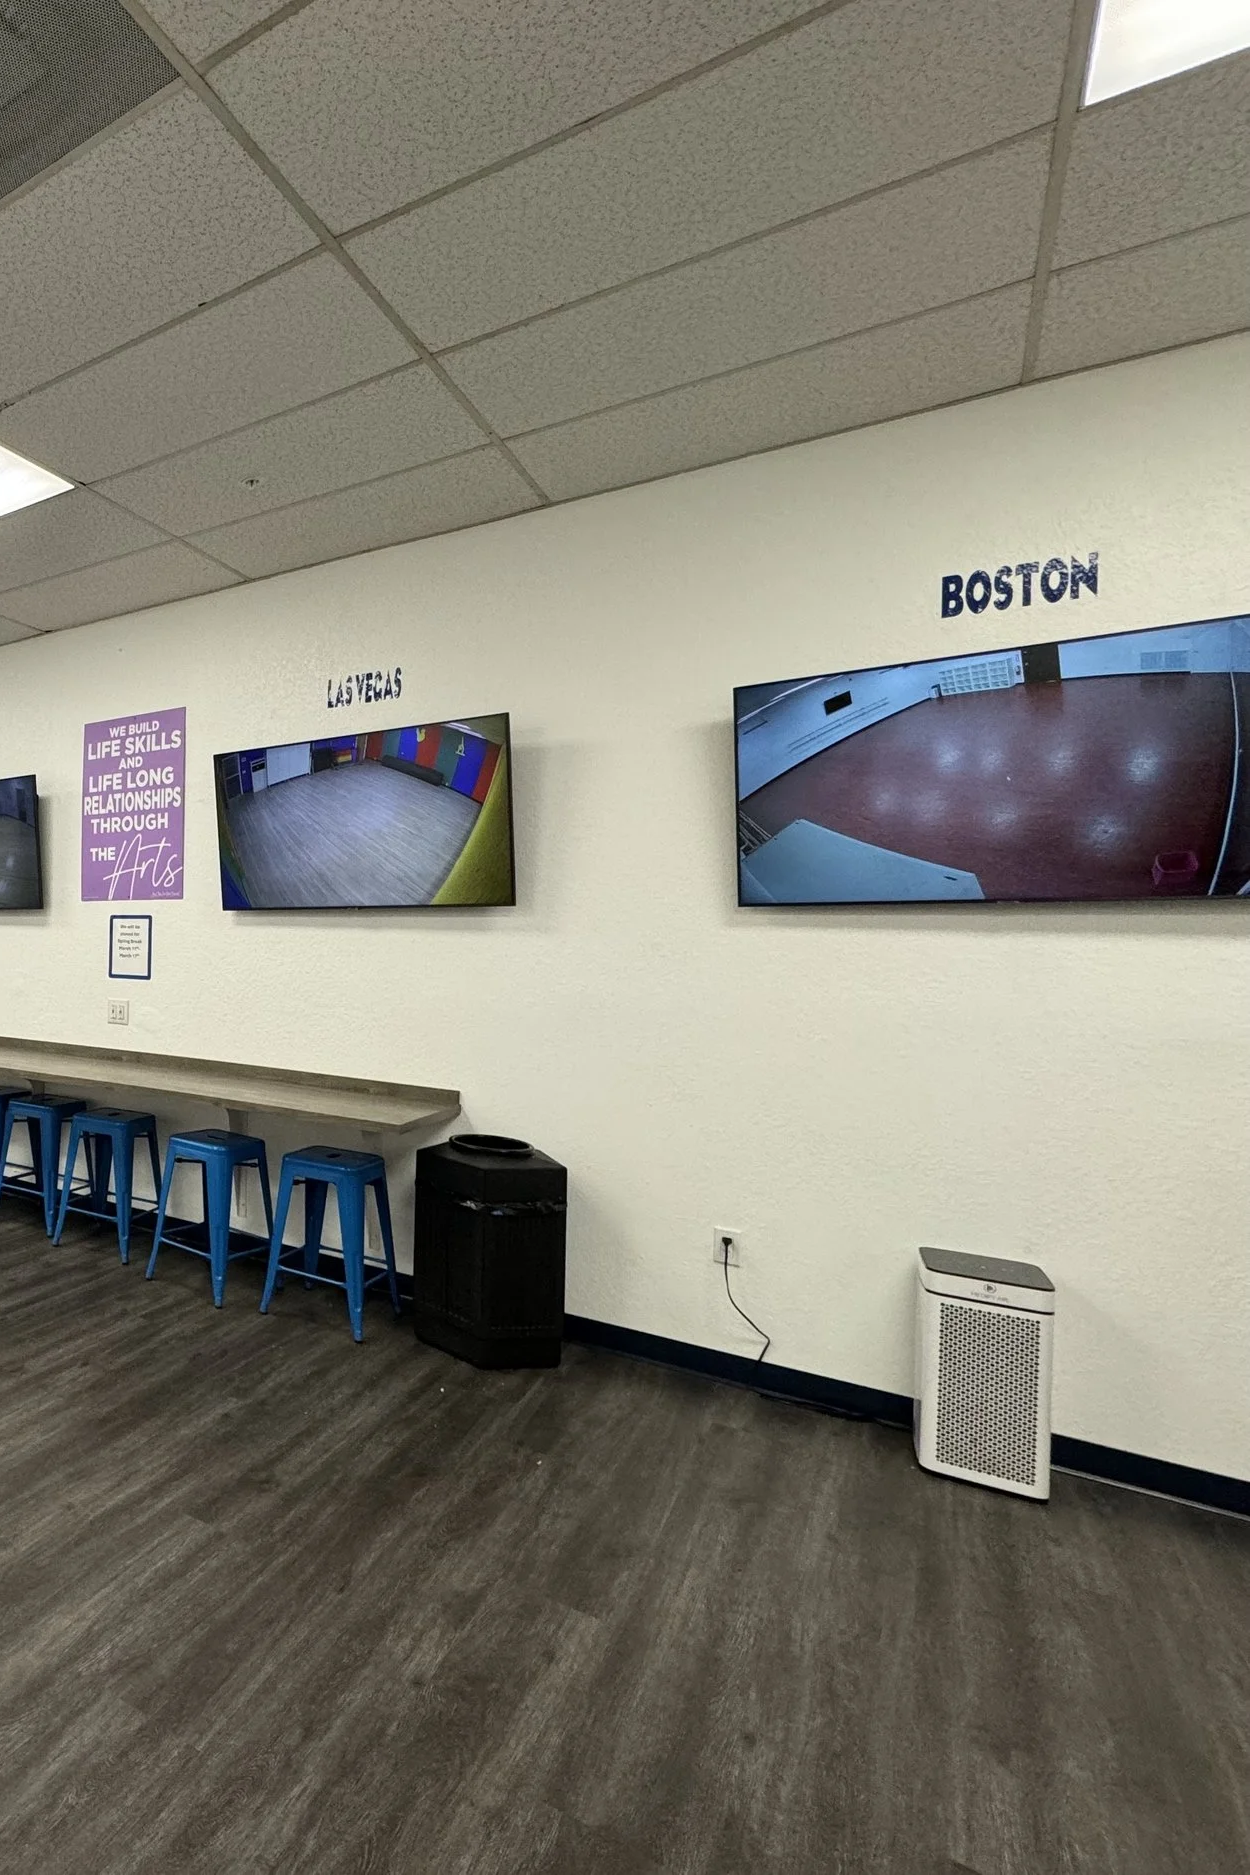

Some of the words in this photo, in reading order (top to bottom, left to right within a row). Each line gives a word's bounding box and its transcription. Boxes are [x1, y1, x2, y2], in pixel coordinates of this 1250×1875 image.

[941, 552, 1099, 618] BOSTON
[327, 678, 352, 708] LAS
[355, 667, 401, 703] VEGAS
[109, 725, 127, 738] WE
[128, 720, 160, 735] BUILD
[87, 739, 121, 760] LIFE
[124, 730, 182, 755] SKILLS
[118, 756, 143, 770] AND
[88, 773, 123, 793] LIFE
[126, 766, 174, 789] LONG
[83, 786, 182, 816] RELATIONSHIPS
[90, 812, 169, 834] THROUGH
[89, 846, 116, 862] THE
[102, 833, 183, 900] Arts
